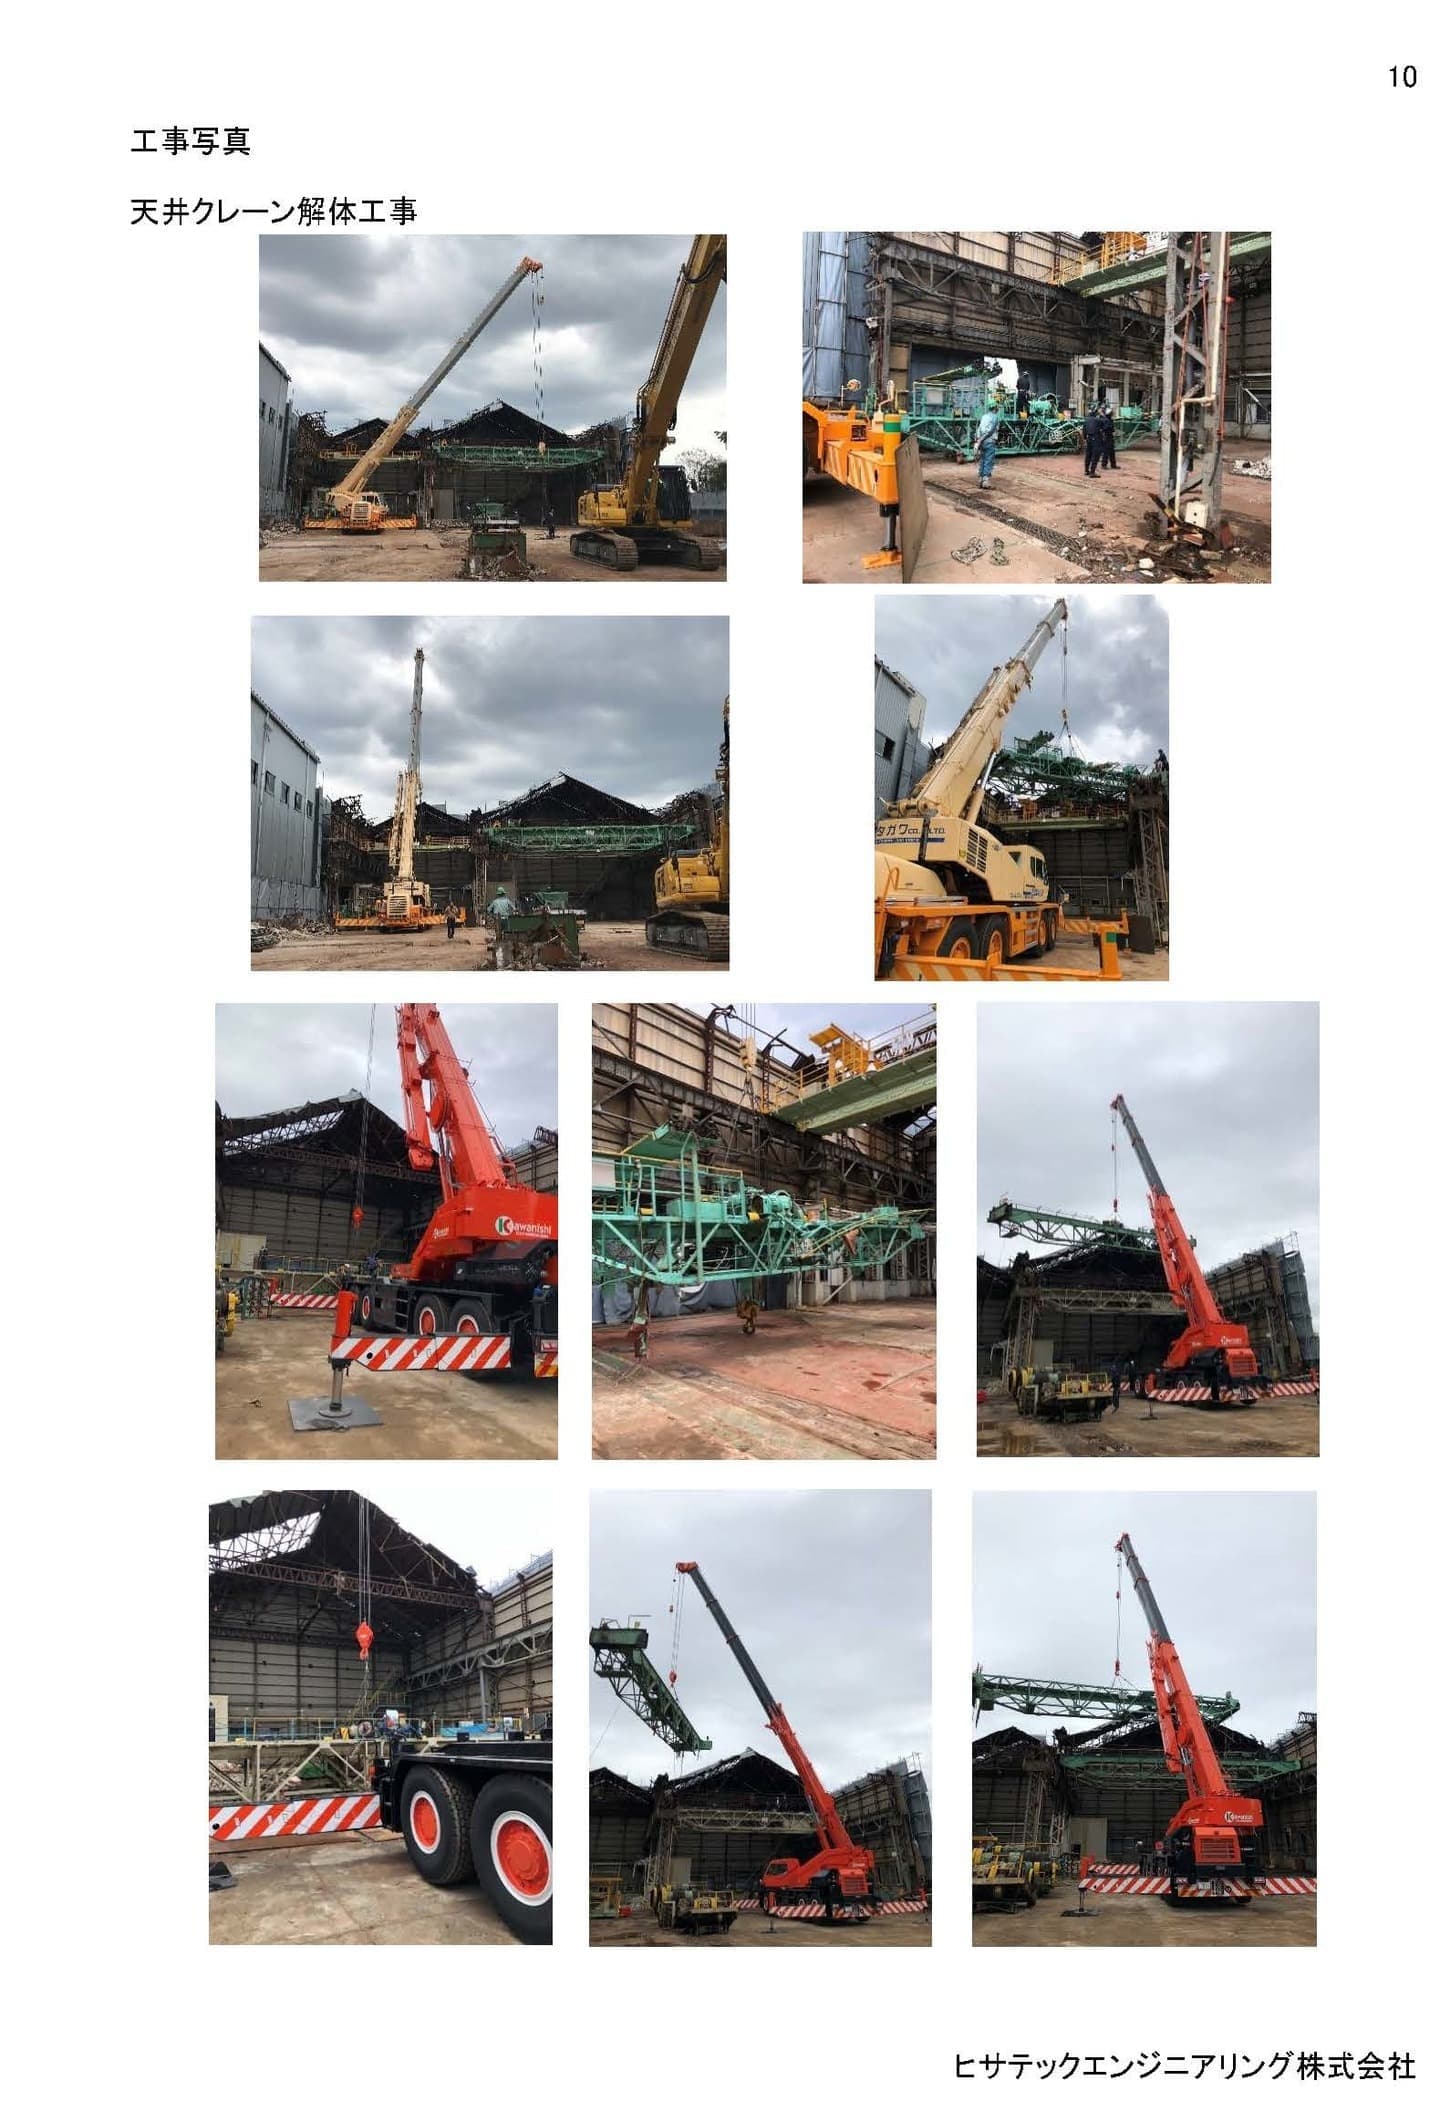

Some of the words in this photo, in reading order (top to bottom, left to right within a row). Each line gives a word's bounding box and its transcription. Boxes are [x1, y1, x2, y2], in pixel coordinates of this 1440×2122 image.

[1389, 65, 1417, 88] 10
[131, 125, 251, 156] 工事写真
[131, 196, 418, 226] 天井クレーン解体工事
[955, 2051, 1417, 2081] ヒサテックエンジニアリング株式会社
